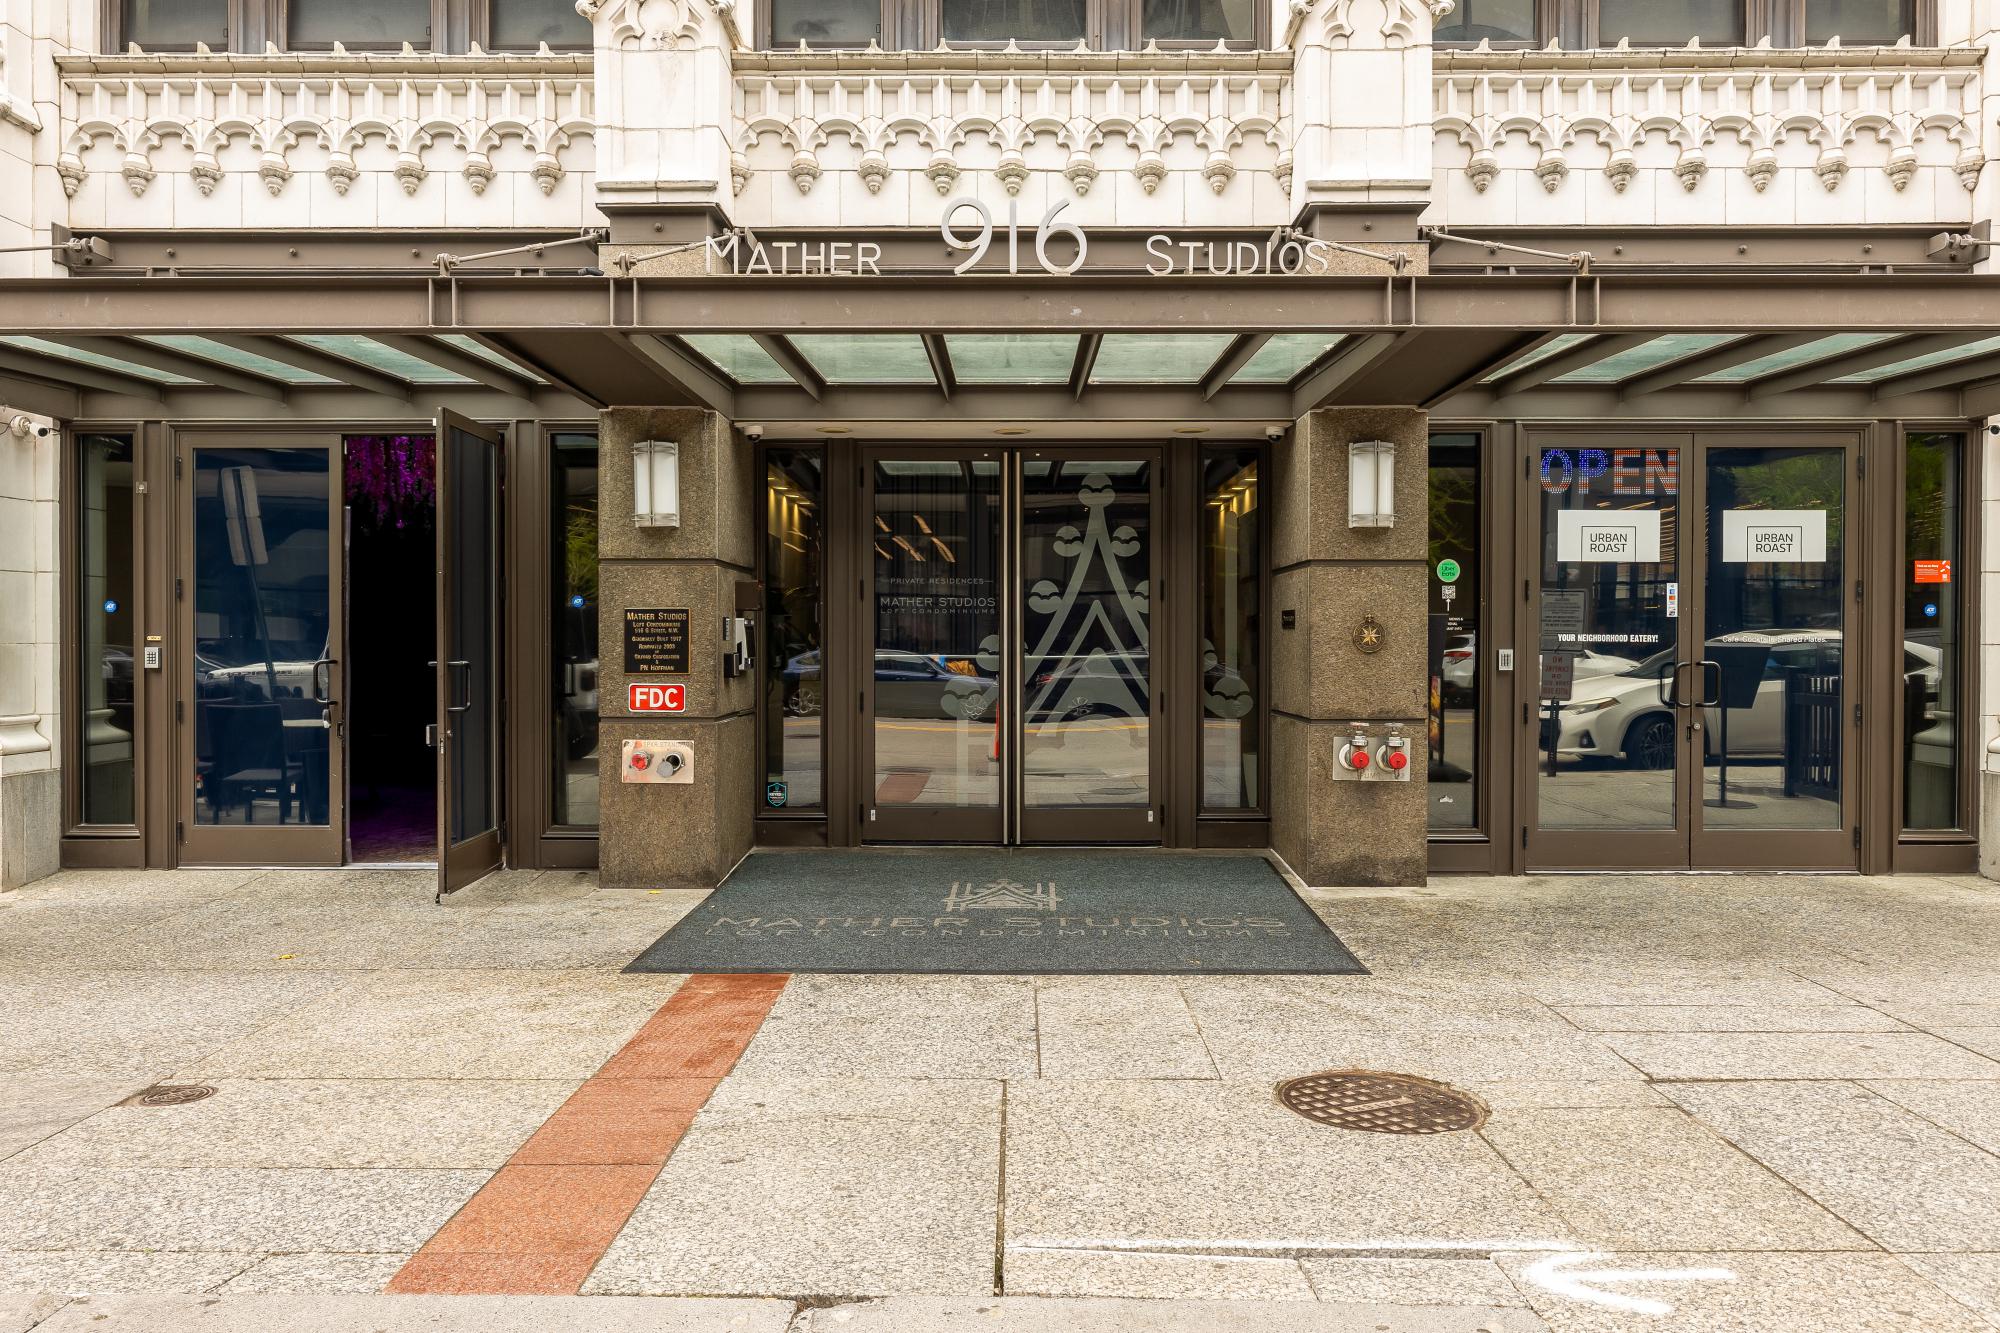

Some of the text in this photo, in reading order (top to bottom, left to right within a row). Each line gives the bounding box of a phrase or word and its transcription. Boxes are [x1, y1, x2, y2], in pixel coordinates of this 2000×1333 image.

[705, 197, 1328, 276] MATHER 916 STUDIOS
[1540, 449, 1677, 494] OPEN
[1590, 533, 1628, 543] URBAN
[1755, 533, 1794, 543] URBAN
[1590, 543, 1628, 553] ROAST
[1755, 543, 1794, 553] ROAST
[880, 597, 996, 607] MATHER STUDIOS
[627, 611, 687, 620] MATHER STUDIOS
[1558, 634, 1659, 643] YOUR NEIGHBORHOOD EATERY!
[1777, 635, 1802, 643] Shared
[635, 687, 679, 708] FDC
[712, 916, 1286, 928] MATHER STUDIOS
